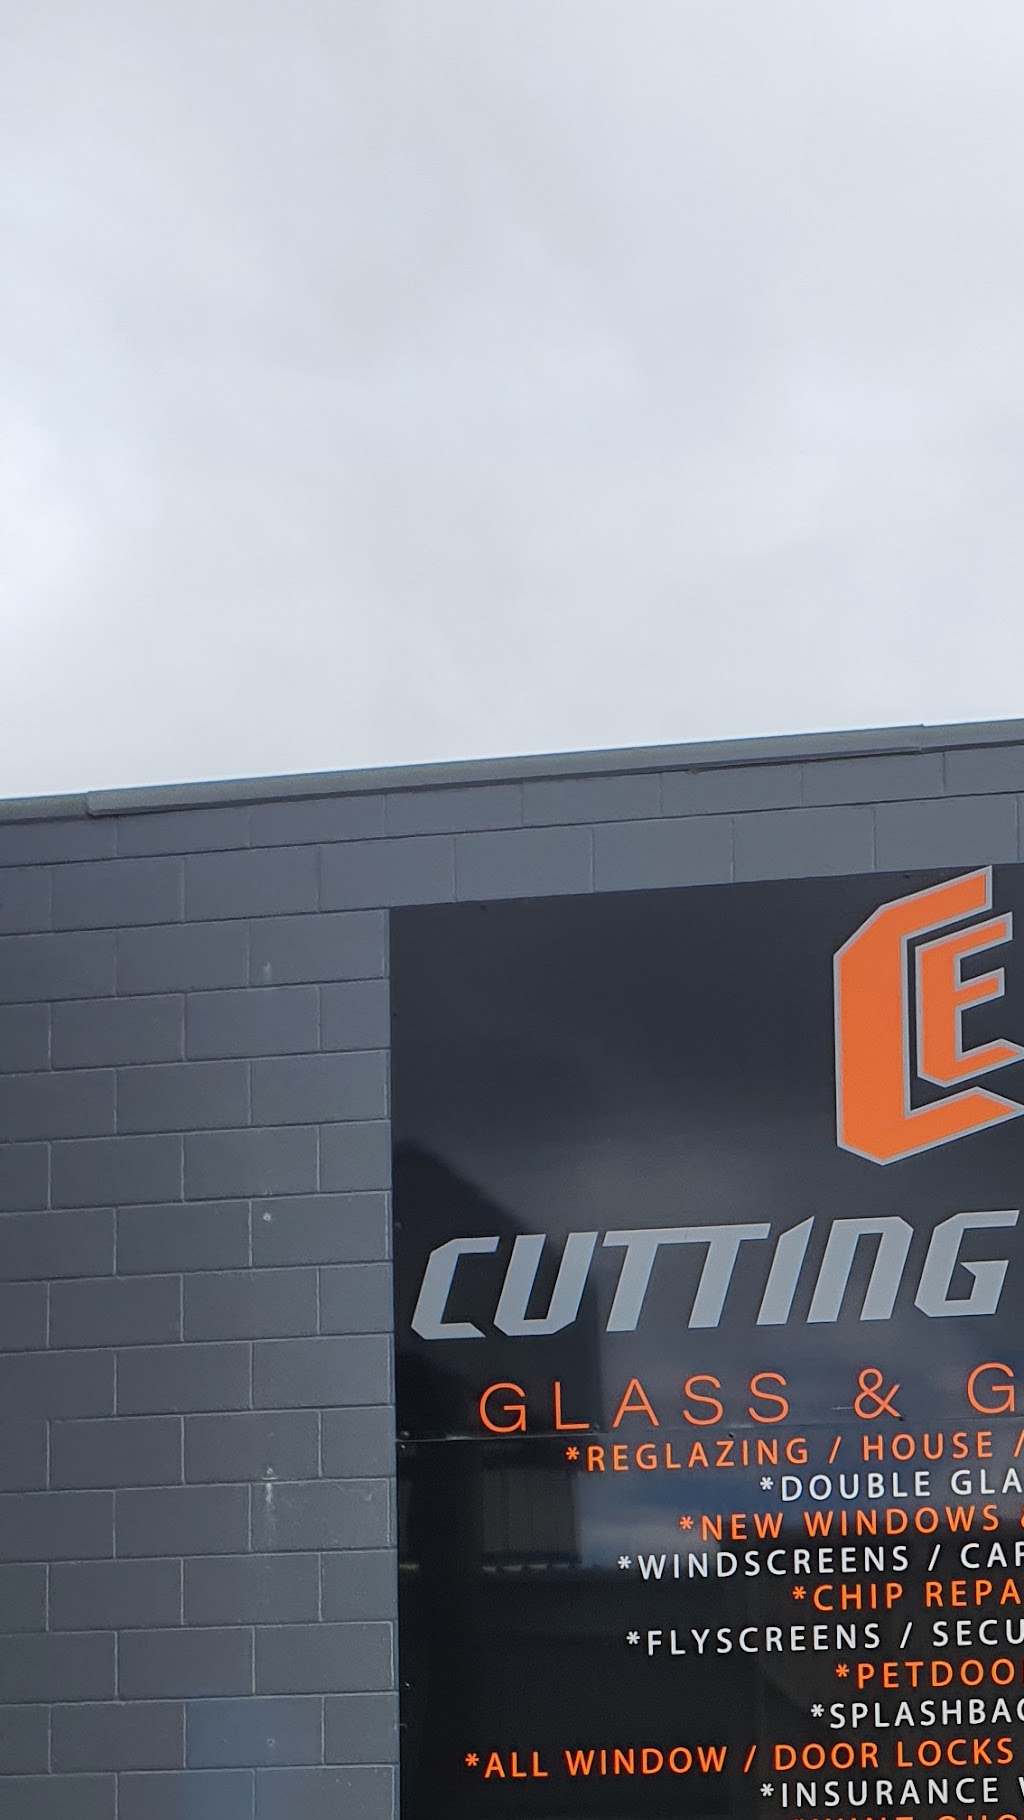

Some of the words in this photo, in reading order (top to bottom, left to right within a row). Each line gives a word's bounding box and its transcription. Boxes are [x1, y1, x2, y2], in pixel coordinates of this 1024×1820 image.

[411, 1209, 1020, 1340] CUTTING
[478, 1372, 789, 1435] GLASS
[853, 1367, 901, 1420] &
[828, 1436, 842, 1464] /
[862, 1430, 993, 1461] HOUSE
[802, 1503, 999, 1538] WINDOWS
[927, 1543, 941, 1572] /
[899, 1621, 913, 1649] /
[563, 1745, 727, 1777] WINDOW
[742, 1744, 757, 1774] /
[772, 1741, 879, 1772] DOOR
[895, 1736, 1014, 1769] LOCKS
